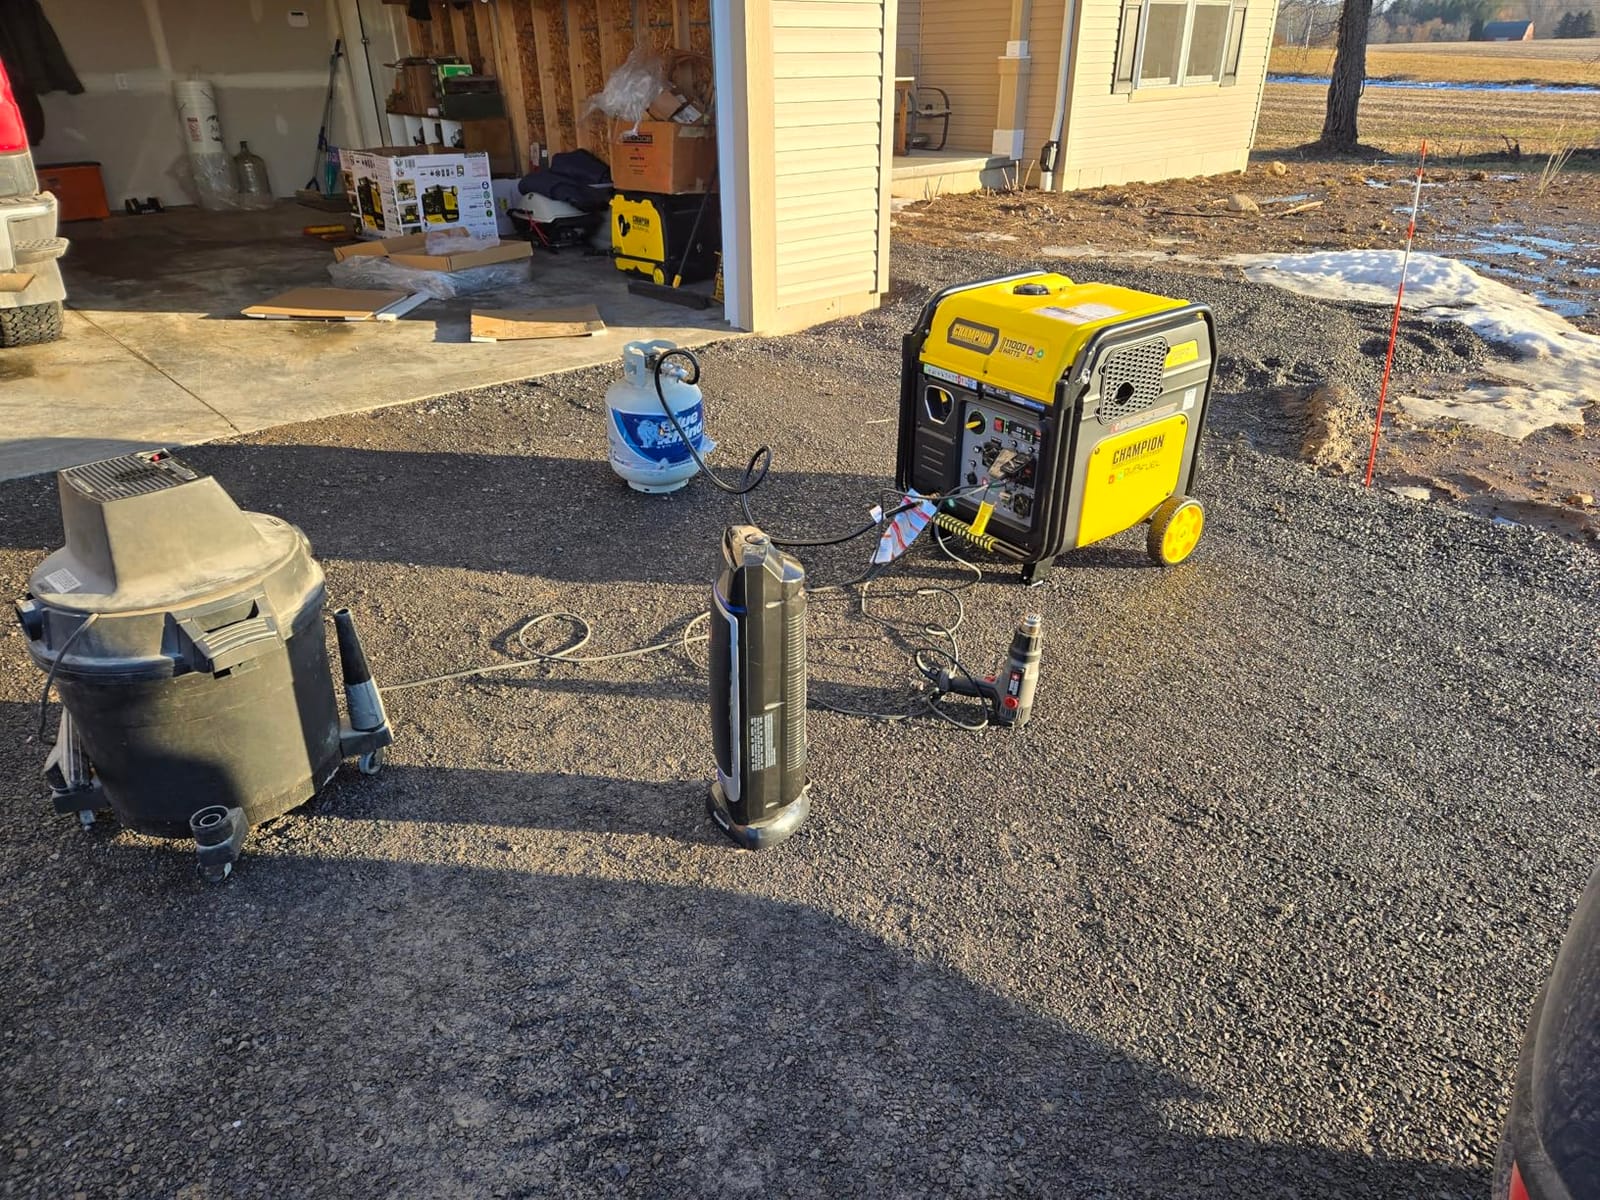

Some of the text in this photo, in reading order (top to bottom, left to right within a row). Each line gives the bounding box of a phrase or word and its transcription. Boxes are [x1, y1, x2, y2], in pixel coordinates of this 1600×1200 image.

[952, 326, 994, 346] CHAMPION
[1003, 348, 1020, 358] WATTS
[1005, 339, 1027, 352] 11000
[1112, 433, 1165, 465] CHAMPION
